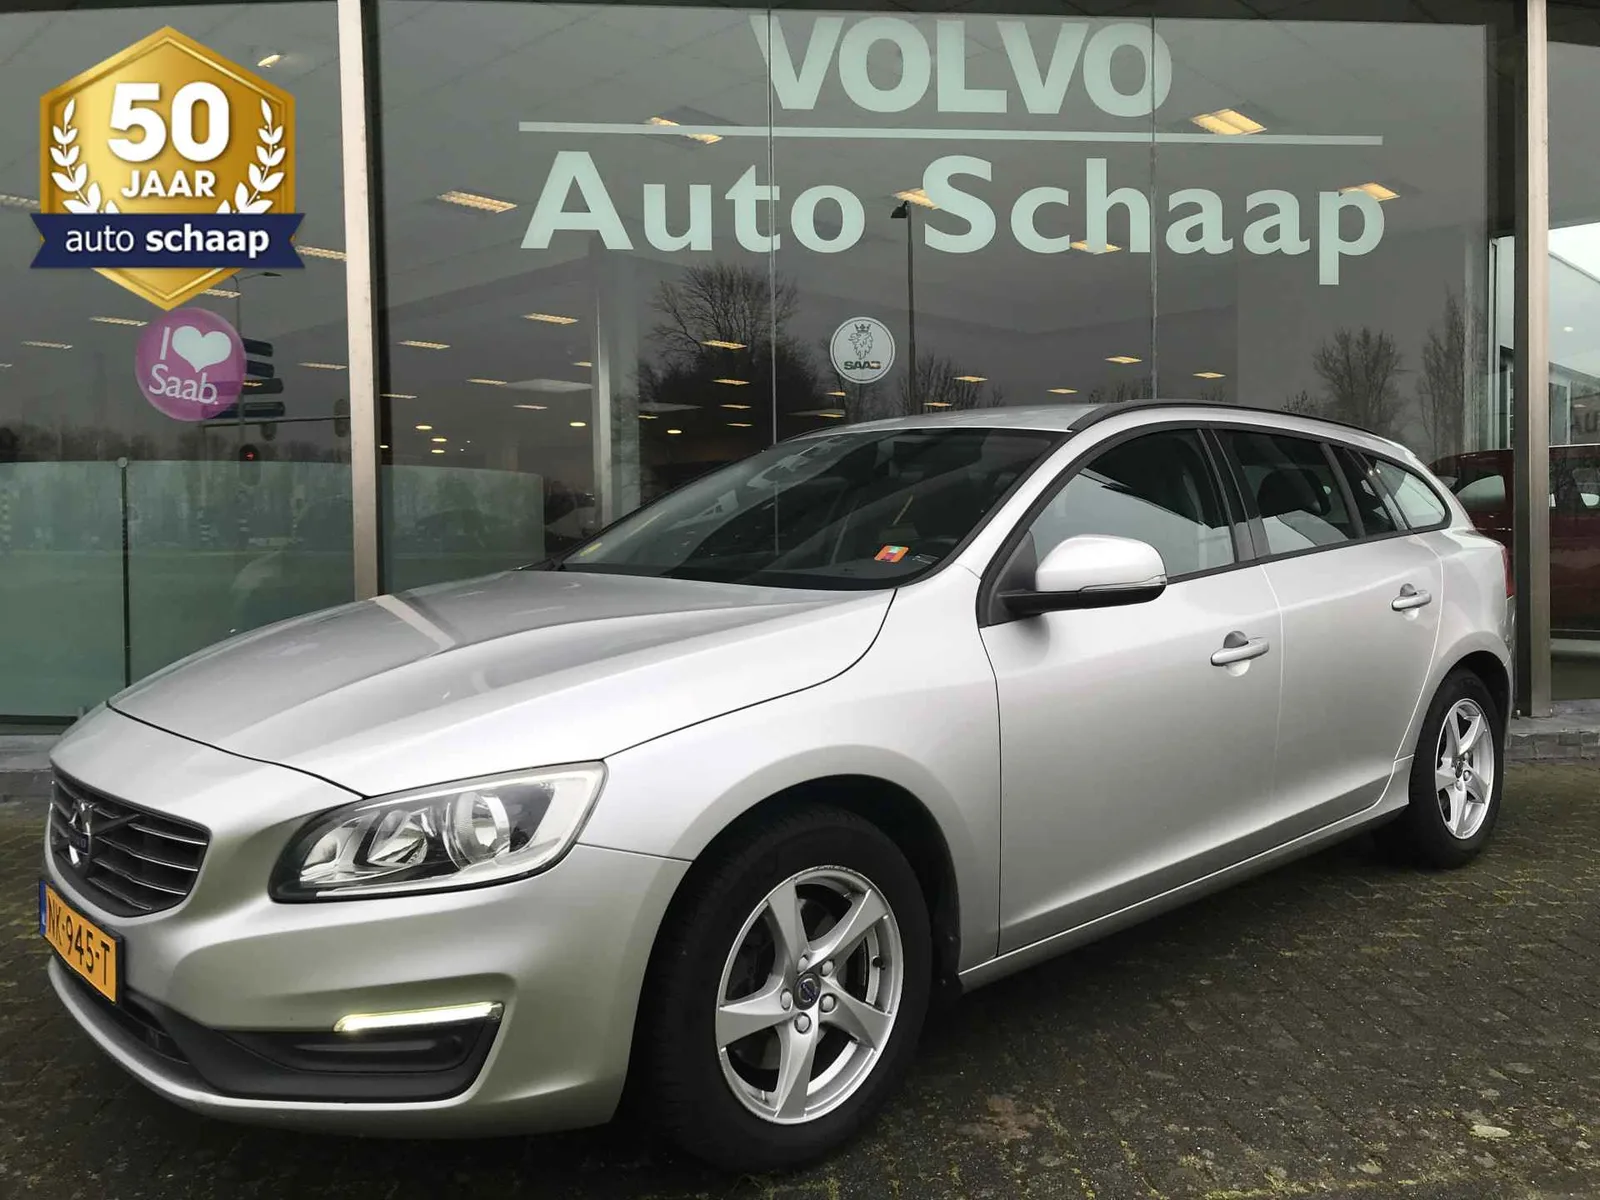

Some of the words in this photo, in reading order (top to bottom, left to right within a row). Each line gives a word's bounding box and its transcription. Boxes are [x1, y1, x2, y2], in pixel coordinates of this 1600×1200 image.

[750, 15, 1172, 117] VOLVO
[520, 151, 866, 254] Auto
[922, 155, 1385, 286] Schaap
[159, 326, 170, 361] I
[47, 897, 110, 986] NK-945-T
